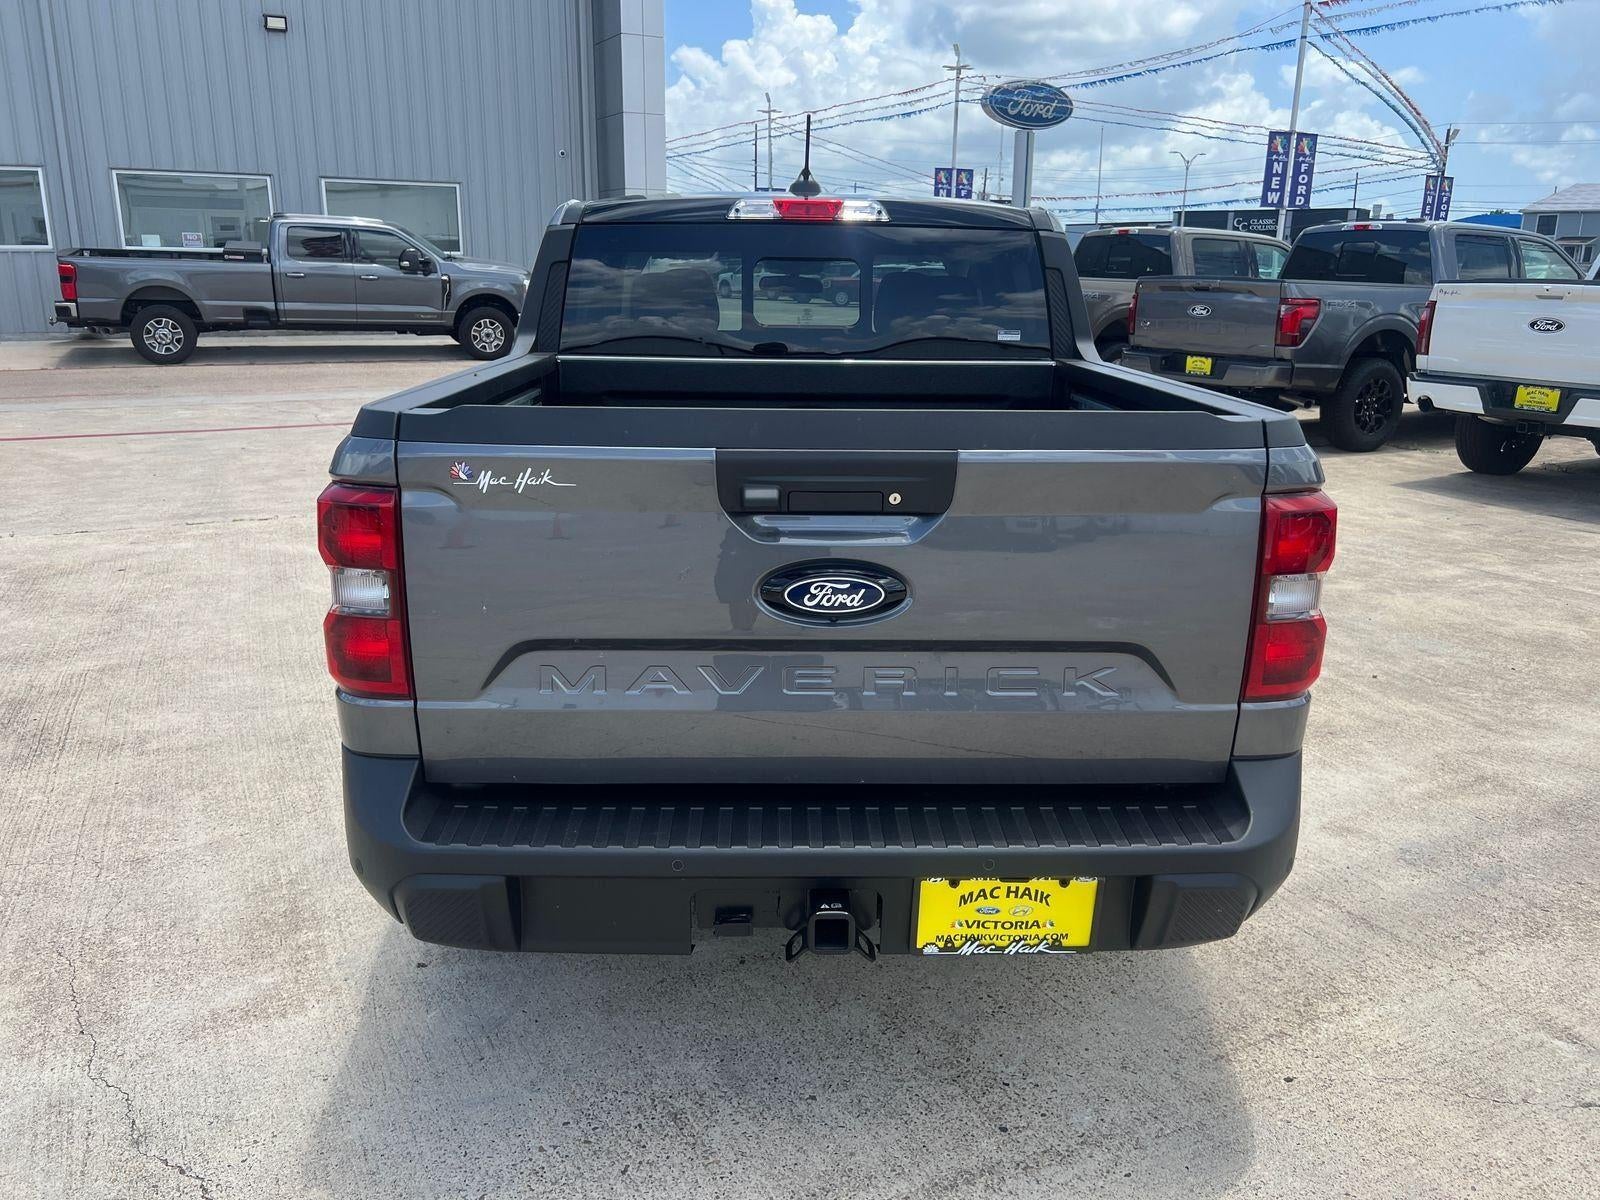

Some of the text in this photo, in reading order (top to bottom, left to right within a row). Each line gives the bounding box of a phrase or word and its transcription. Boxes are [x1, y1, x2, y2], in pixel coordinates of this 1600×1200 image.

[1007, 88, 1058, 119] Ford
[1267, 161, 1283, 204] NEW
[1295, 163, 1309, 206] FORD
[1439, 196, 1448, 221] FOR
[1326, 300, 1357, 311] FX4
[1533, 319, 1559, 331] Ford
[476, 467, 576, 493] Mac Haik
[803, 581, 865, 608] Ford
[538, 664, 1119, 697] MAVERICK
[958, 885, 1052, 908] MAC HAIK
[977, 906, 999, 915] Ford
[964, 919, 1042, 931] VICTORIA
[935, 933, 1069, 943] MACHAIKVICTORIA.COM
[957, 940, 1076, 956] Mac Haik
